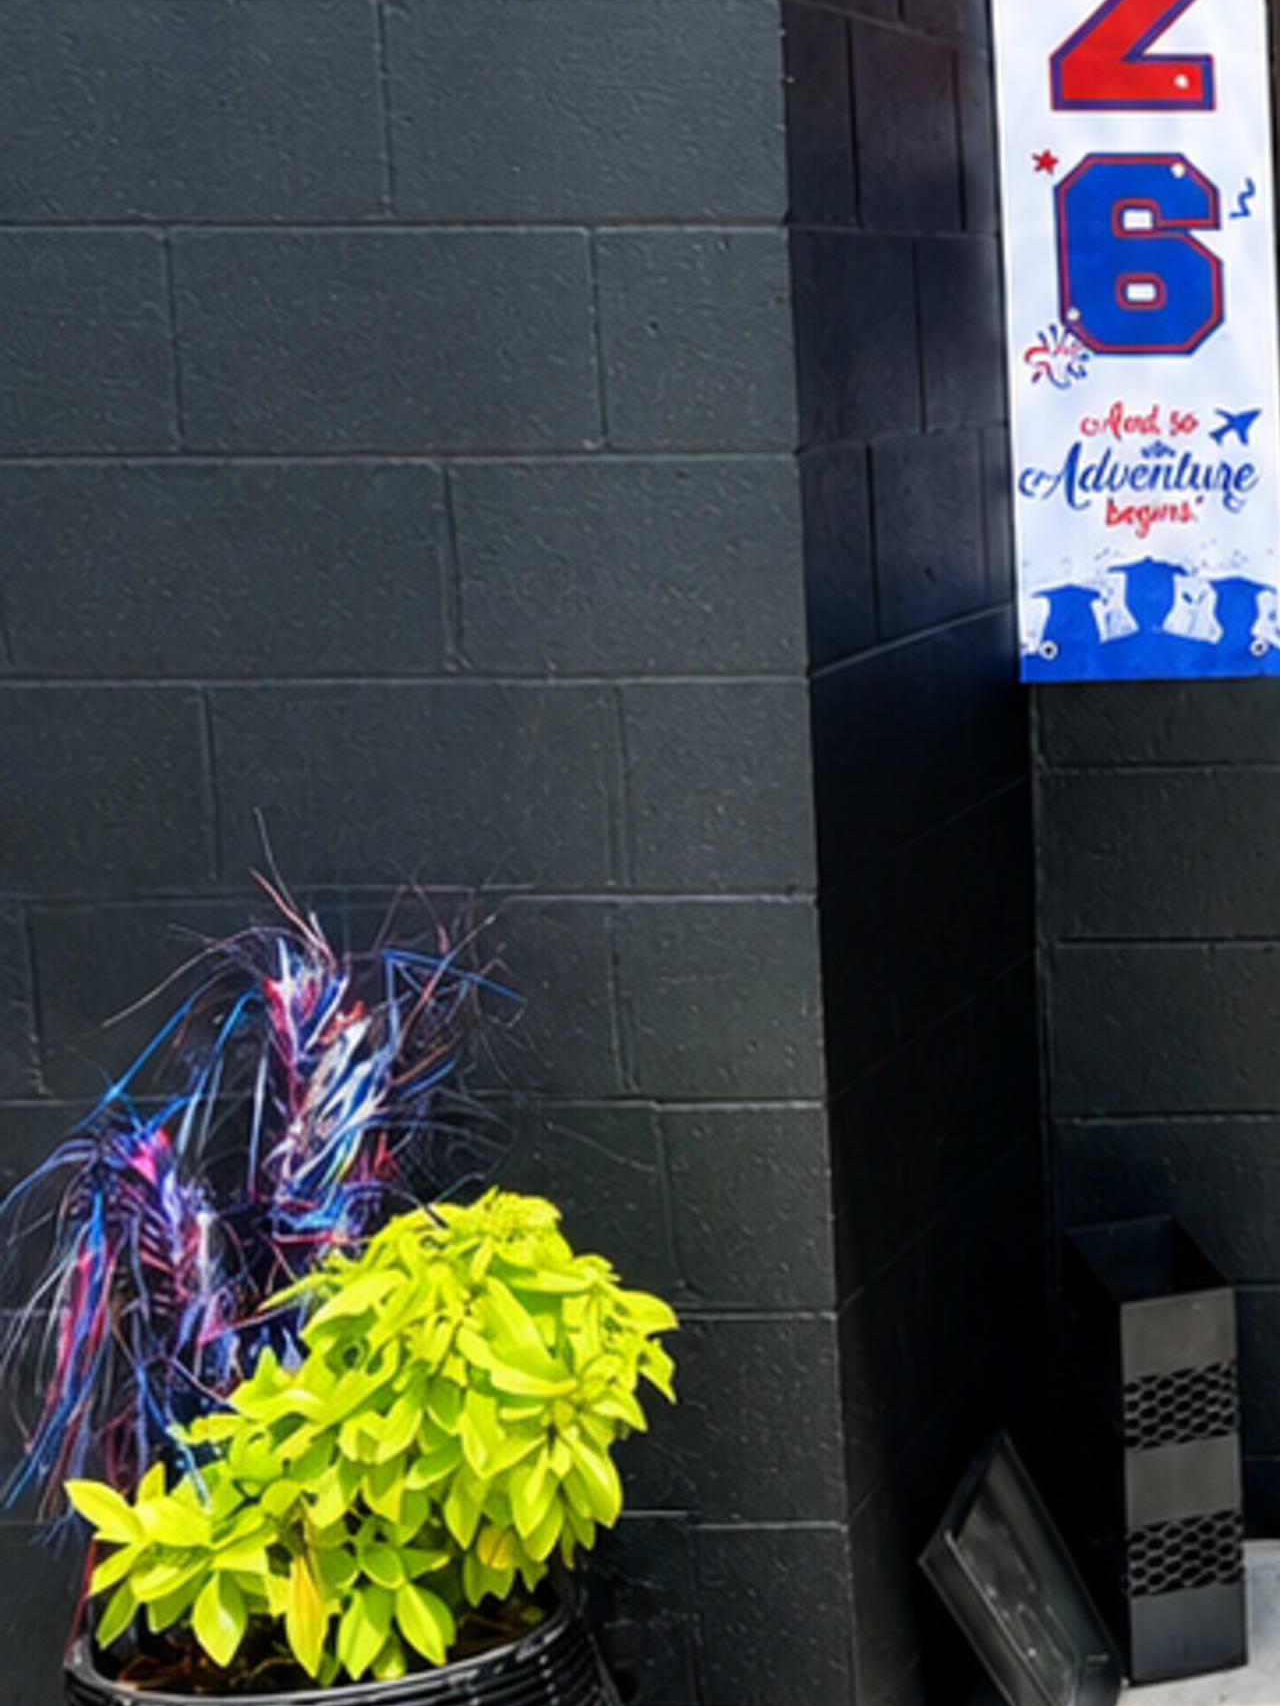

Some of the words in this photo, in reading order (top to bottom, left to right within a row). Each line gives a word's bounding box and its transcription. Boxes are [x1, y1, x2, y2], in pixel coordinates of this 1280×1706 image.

[1080, 401, 1161, 440] And
[1169, 409, 1199, 436] so
[1018, 440, 1259, 514] Adventure
